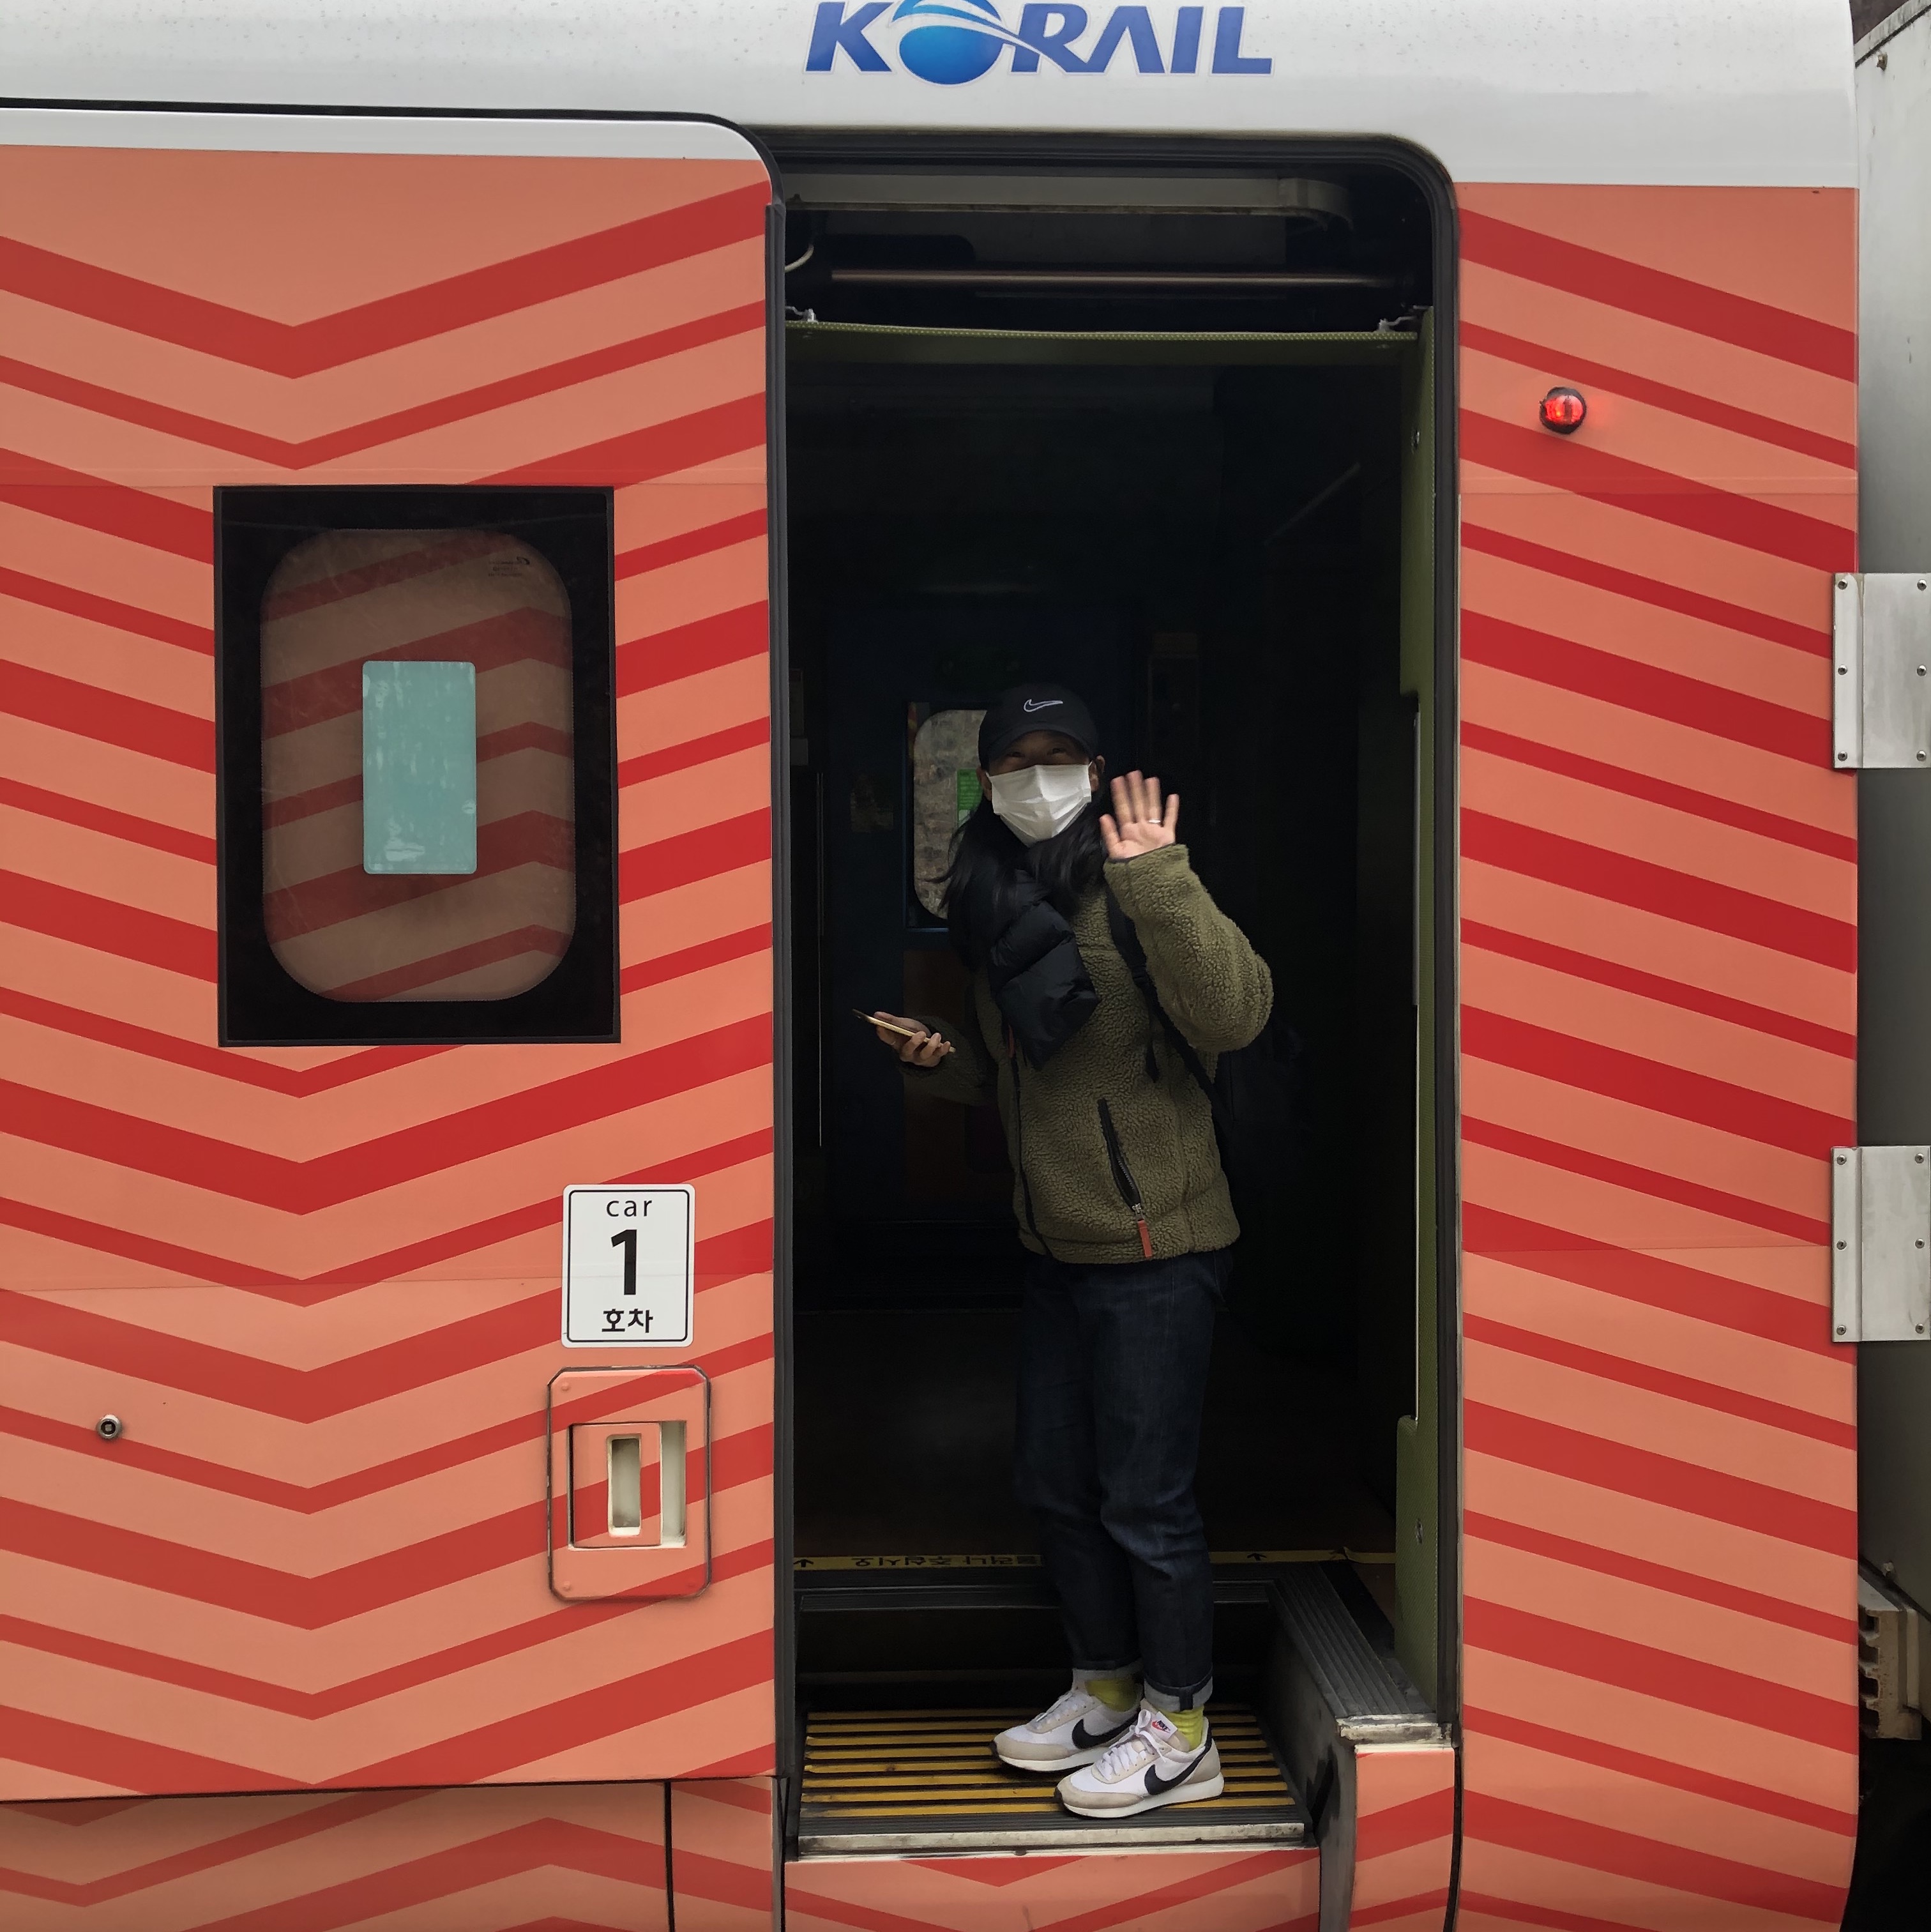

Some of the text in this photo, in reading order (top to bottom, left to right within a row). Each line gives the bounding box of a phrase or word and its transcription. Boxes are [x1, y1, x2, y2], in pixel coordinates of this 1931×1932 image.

[805, 0, 1273, 85] KORAIL
[606, 1200, 652, 1217] car
[610, 1229, 637, 1295] 1
[602, 1308, 654, 1334] 호차
[851, 1556, 952, 1567] 주십시오
